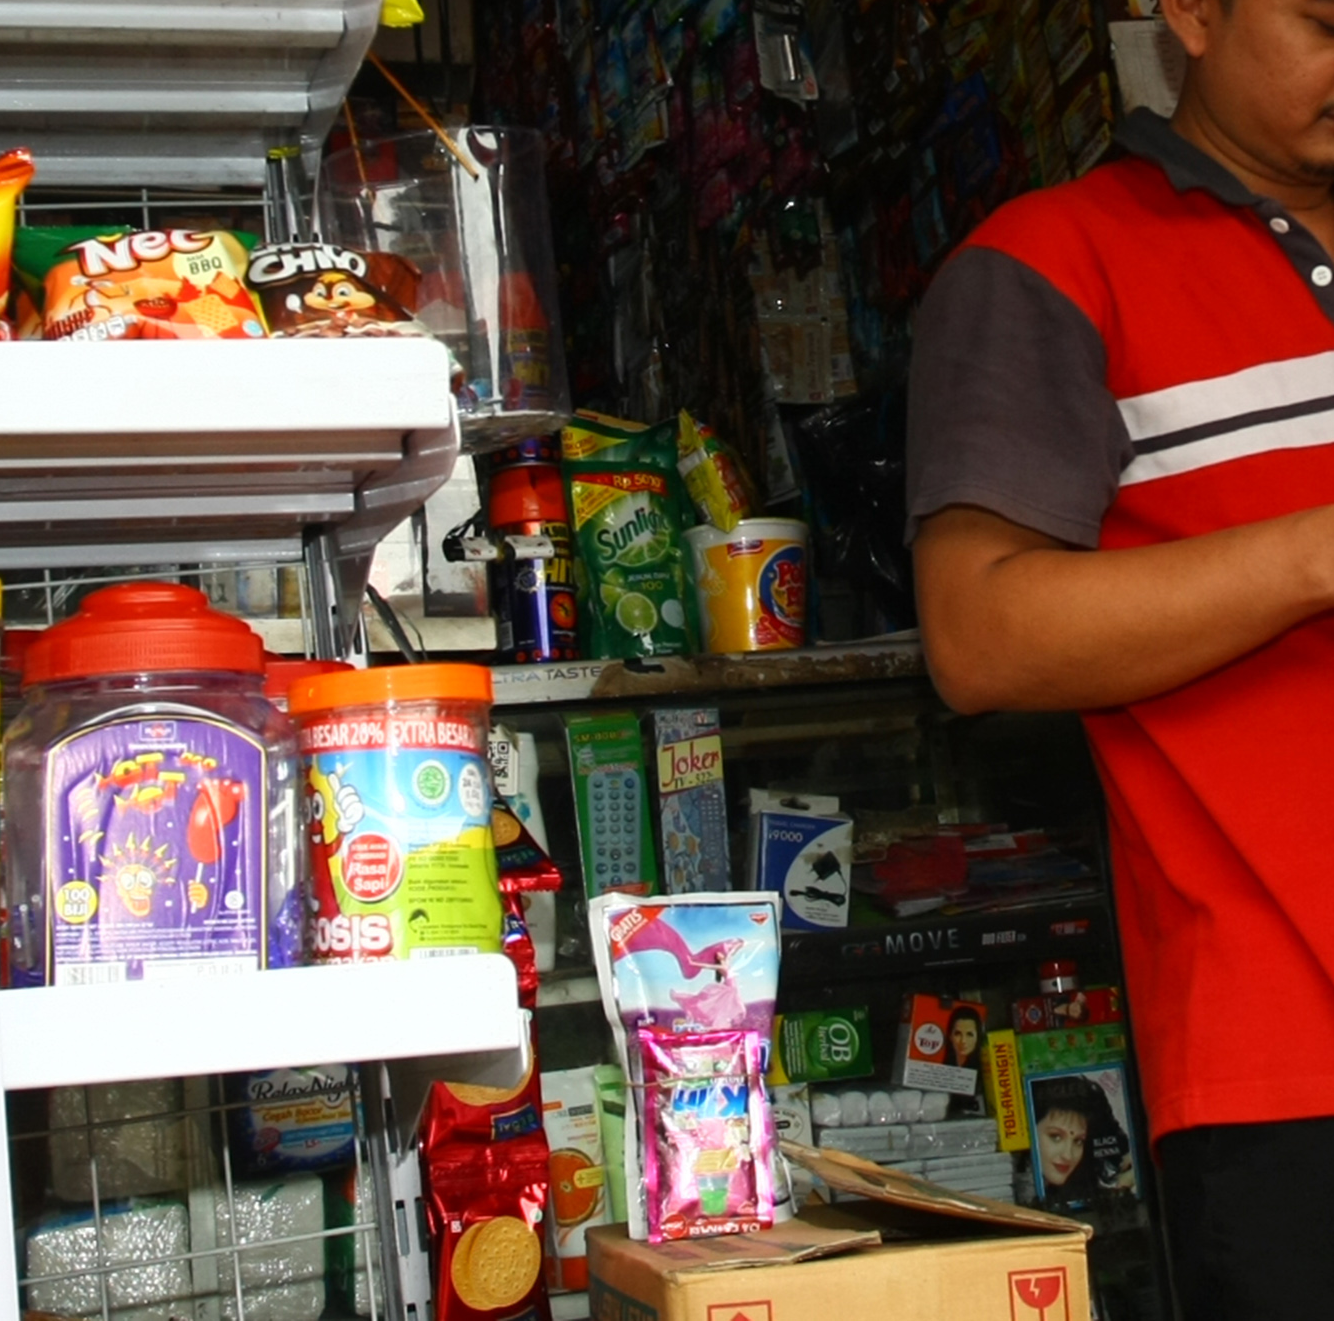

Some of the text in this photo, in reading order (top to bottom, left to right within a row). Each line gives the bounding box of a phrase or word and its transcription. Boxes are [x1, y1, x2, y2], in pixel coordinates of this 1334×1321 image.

[188, 257, 224, 276] BBQ
[545, 666, 603, 680] TASTE
[312, 719, 349, 747] BESAR
[351, 719, 384, 744] 20%
[661, 740, 721, 788] Joker
[349, 861, 387, 877] Rasa
[61, 887, 91, 901] 100
[353, 876, 385, 894] Sapi
[609, 909, 644, 943] GRATIS
[885, 927, 961, 956] MOVE
[827, 1020, 852, 1064] OB
[1092, 1136, 1119, 1148] BLACK
[1093, 1147, 1121, 1159] HENNA
